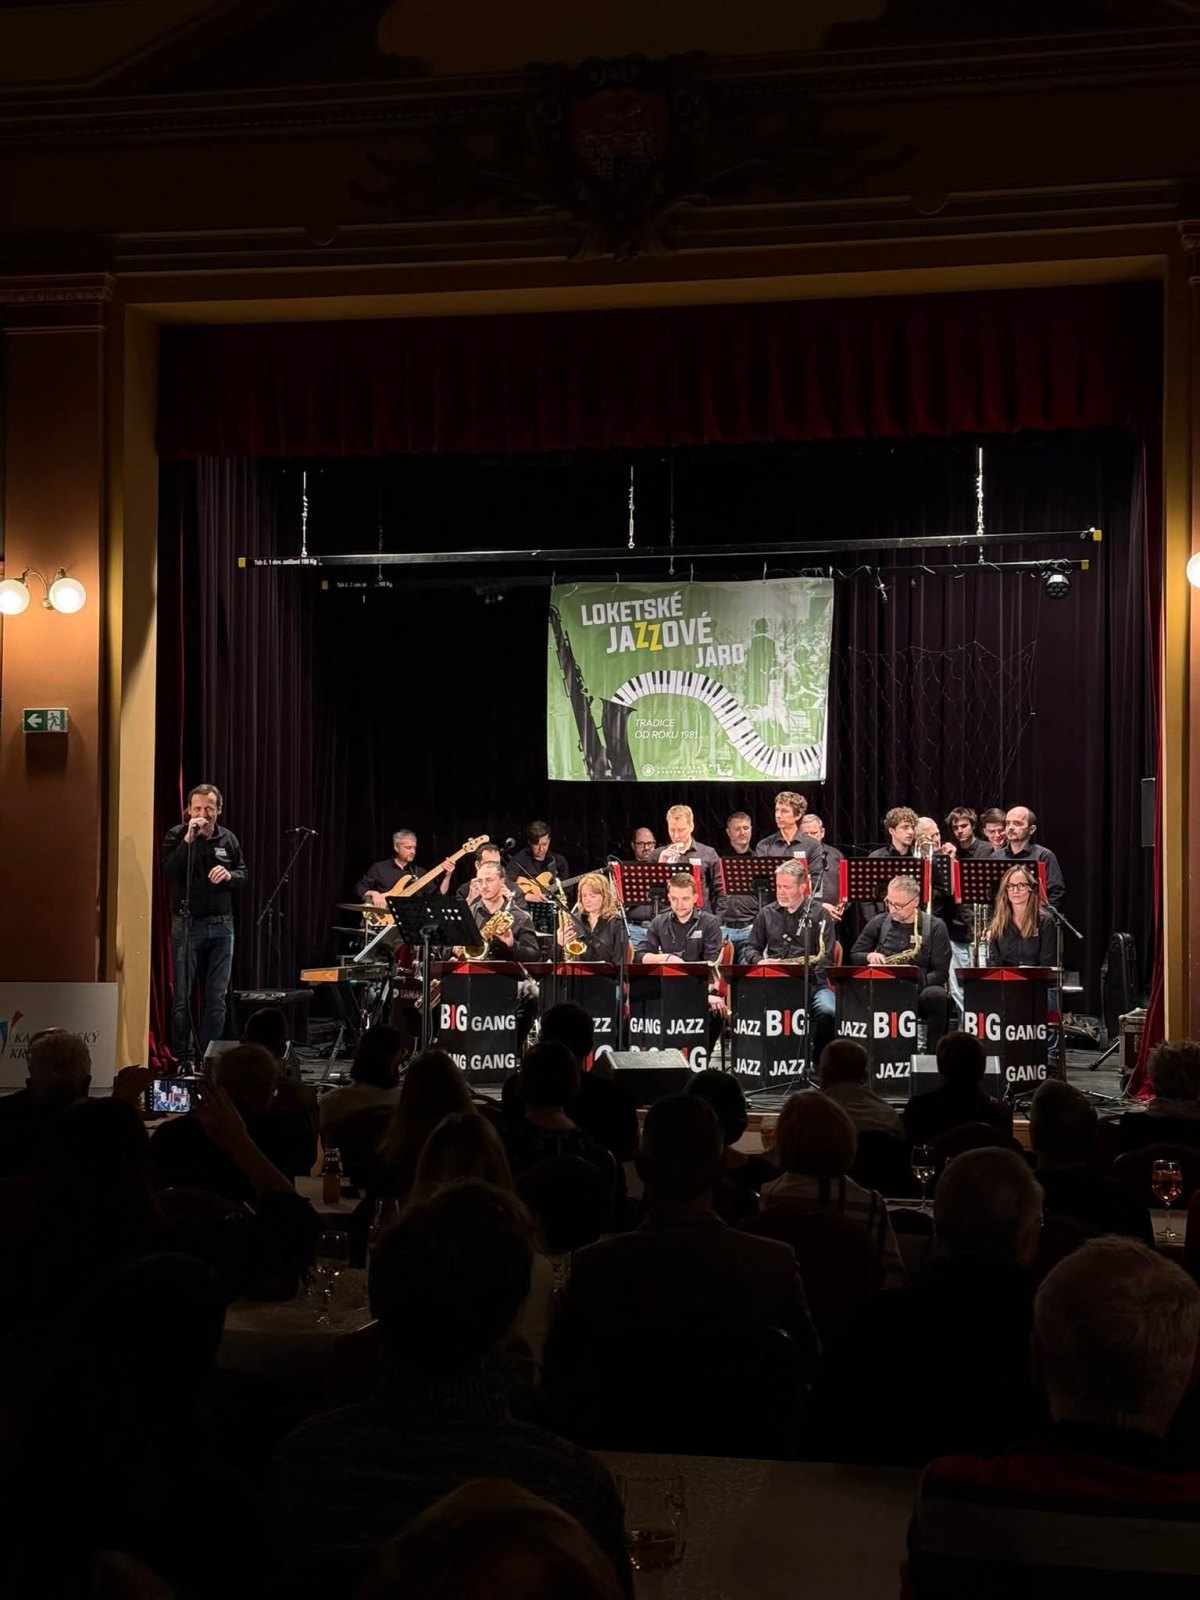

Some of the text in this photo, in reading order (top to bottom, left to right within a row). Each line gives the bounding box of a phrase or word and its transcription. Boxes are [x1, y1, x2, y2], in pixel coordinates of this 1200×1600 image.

[581, 591, 683, 626] LOKETSKÉ
[606, 612, 713, 654] JAZZOVÉ
[695, 643, 746, 668] JARO
[635, 719, 675, 727] TRADICE
[635, 731, 698, 739] OD ROKU 1981
[440, 1003, 516, 1032] BIG GANG
[592, 1017, 612, 1032] ZZ
[630, 1017, 704, 1035] GANG JAZZ
[733, 1008, 809, 1037] JAZZ BIG
[837, 1010, 916, 1039] JAZZ BIG
[964, 1011, 1047, 1041] BIG GANG
[470, 1053, 516, 1070] GANG
[733, 1057, 805, 1076] JAZZ JAZZ
[875, 1062, 911, 1079] JAZZ
[1005, 1064, 1047, 1082] GANG
